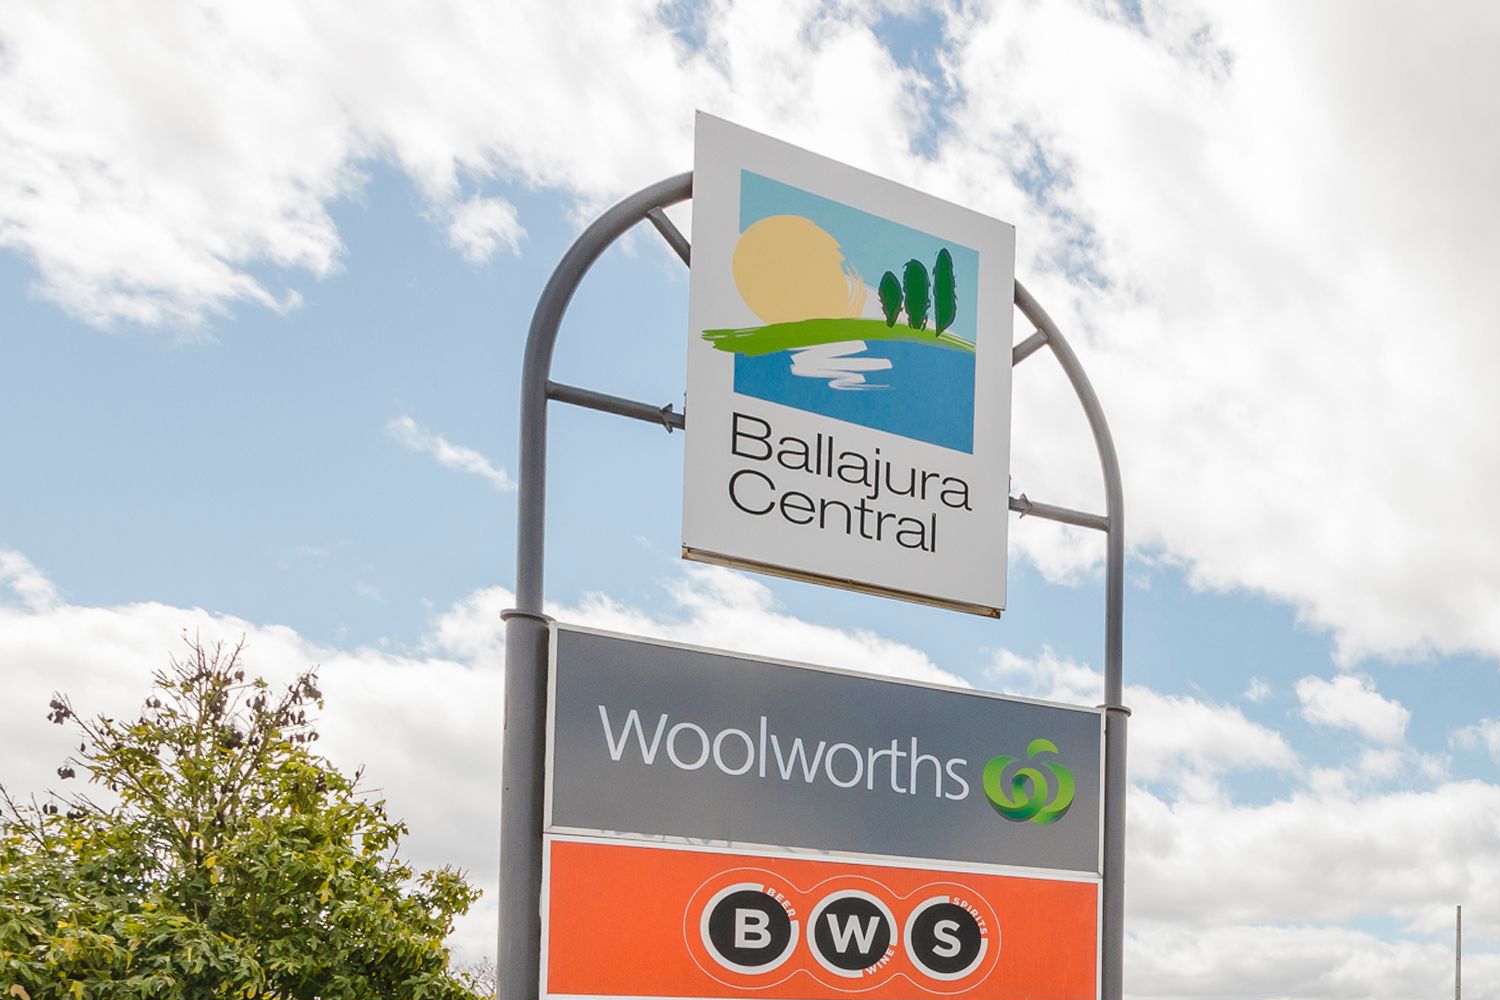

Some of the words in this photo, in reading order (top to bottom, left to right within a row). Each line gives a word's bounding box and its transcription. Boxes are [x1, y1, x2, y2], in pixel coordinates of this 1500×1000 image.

[731, 411, 973, 512] Ballajura
[728, 469, 937, 553] Central
[598, 704, 970, 801] Woolworths
[766, 887, 797, 918] BEER
[952, 896, 988, 935] SPIRITS
[865, 948, 895, 976] WINE
